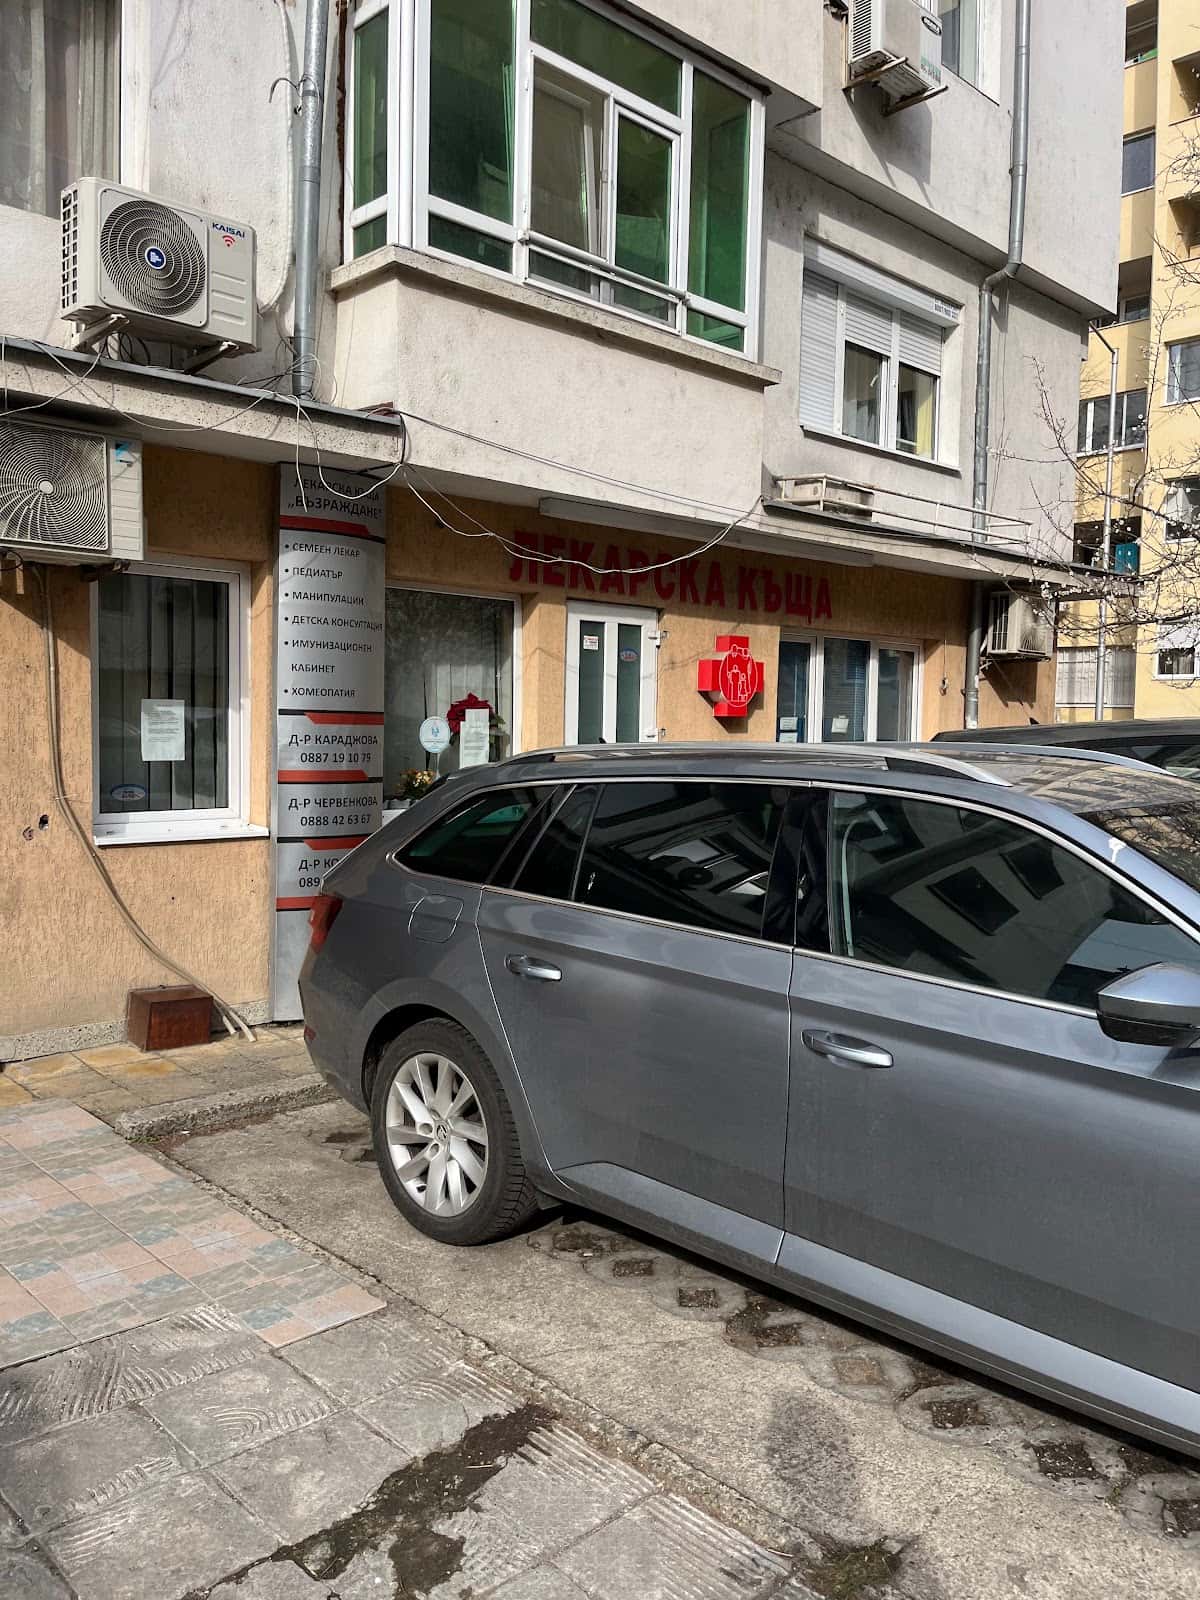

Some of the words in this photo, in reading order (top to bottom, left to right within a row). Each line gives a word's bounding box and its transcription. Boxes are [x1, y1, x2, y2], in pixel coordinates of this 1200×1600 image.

[212, 222, 245, 238] KAISAI
[292, 542, 331, 555] СЕМЕЕН
[333, 545, 361, 558] ЛЕКАР
[292, 567, 343, 580] ПЕДИАТЪР
[508, 530, 726, 609] ЛЕКАРСКА
[737, 565, 833, 625] КЪЩА
[292, 591, 365, 606] МАНИПУЛАЦИИ
[291, 615, 329, 627] ДЕТСКА
[331, 618, 383, 632] КОНСУЛТАЦИЯ
[291, 663, 336, 674] КАБИНЕТ
[291, 687, 356, 699] ХОМЕОПАТИЯ
[288, 734, 311, 747] Д-Р
[314, 734, 378, 748] КАРАДЖОВА
[300, 752, 329, 763] 0887
[333, 752, 345, 763] 19
[348, 752, 359, 763] 10
[361, 752, 371, 762] 79
[288, 798, 311, 811] Д-Р
[314, 796, 378, 808] ЧЕРВЕНКОВА
[300, 815, 329, 827] 0888
[332, 815, 345, 825] 42
[348, 814, 359, 825] 63
[361, 814, 371, 824] 67
[298, 859, 320, 872] Д-Р
[298, 876, 321, 888] 089
